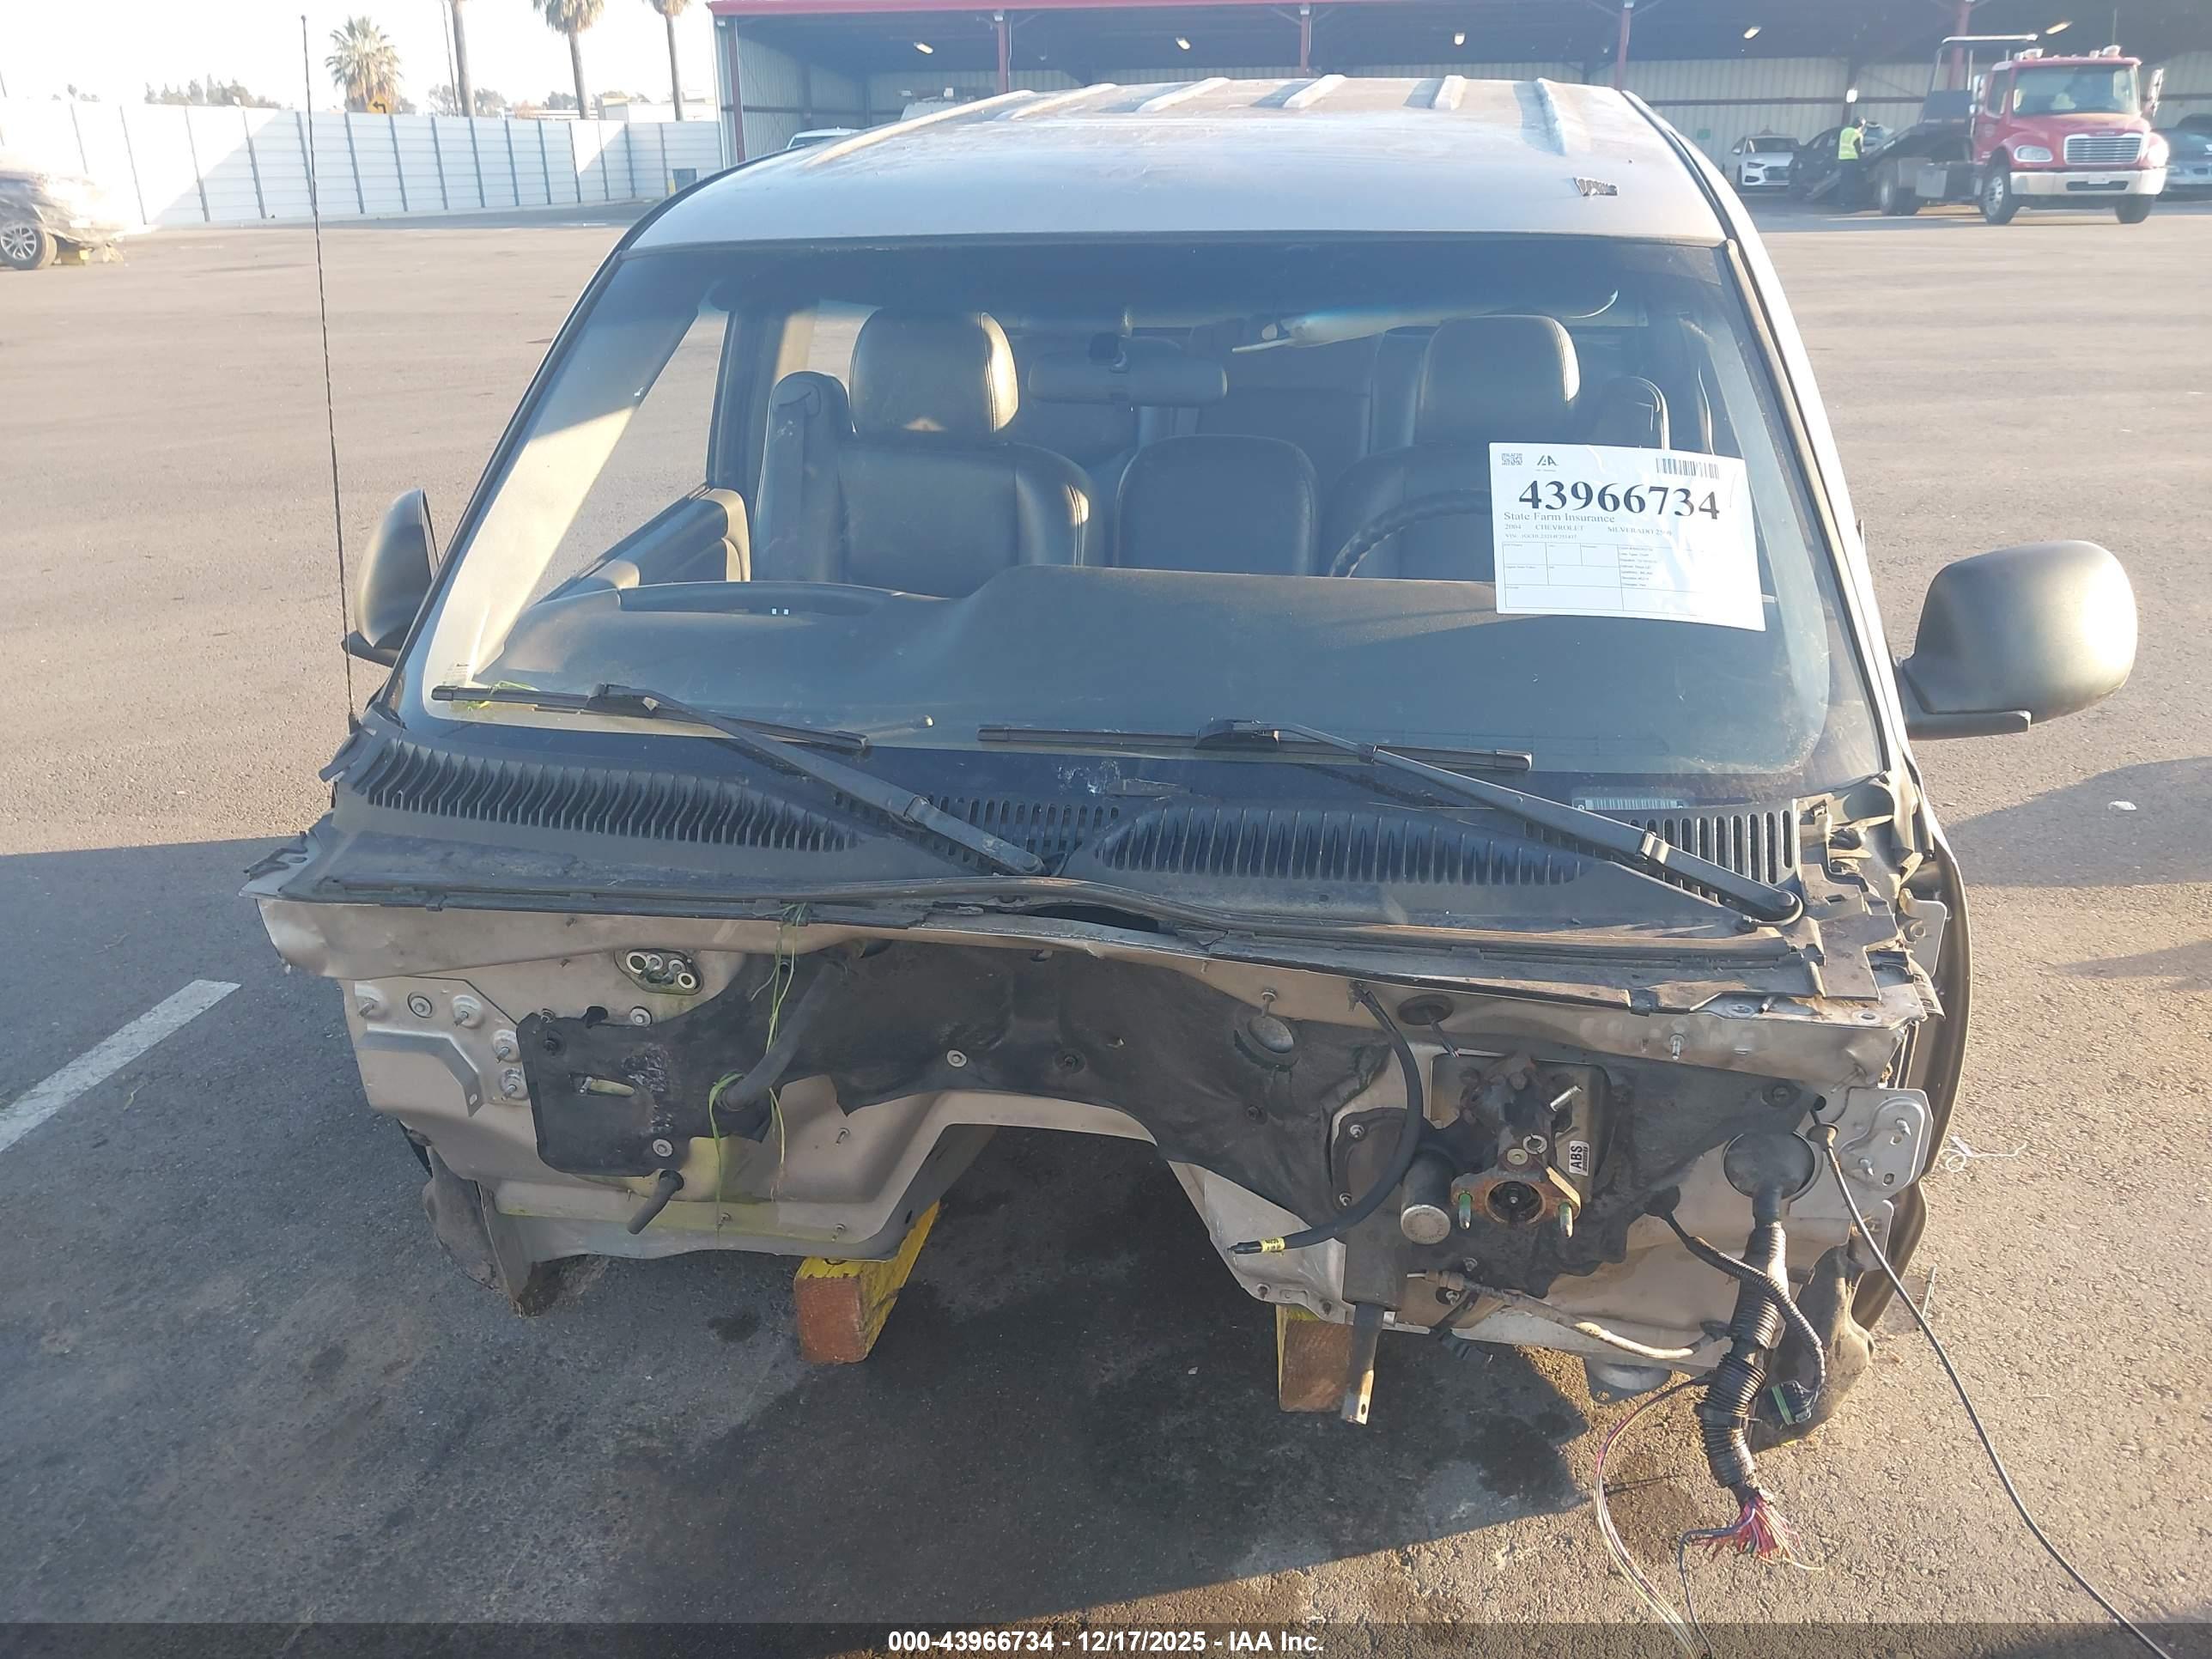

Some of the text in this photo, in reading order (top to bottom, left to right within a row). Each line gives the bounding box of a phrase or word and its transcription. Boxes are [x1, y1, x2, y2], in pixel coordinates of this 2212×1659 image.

[1519, 480, 1720, 520] 43966734
[1504, 511, 1615, 523] State Farm Insurance
[1571, 1146, 1583, 1169] ABS
